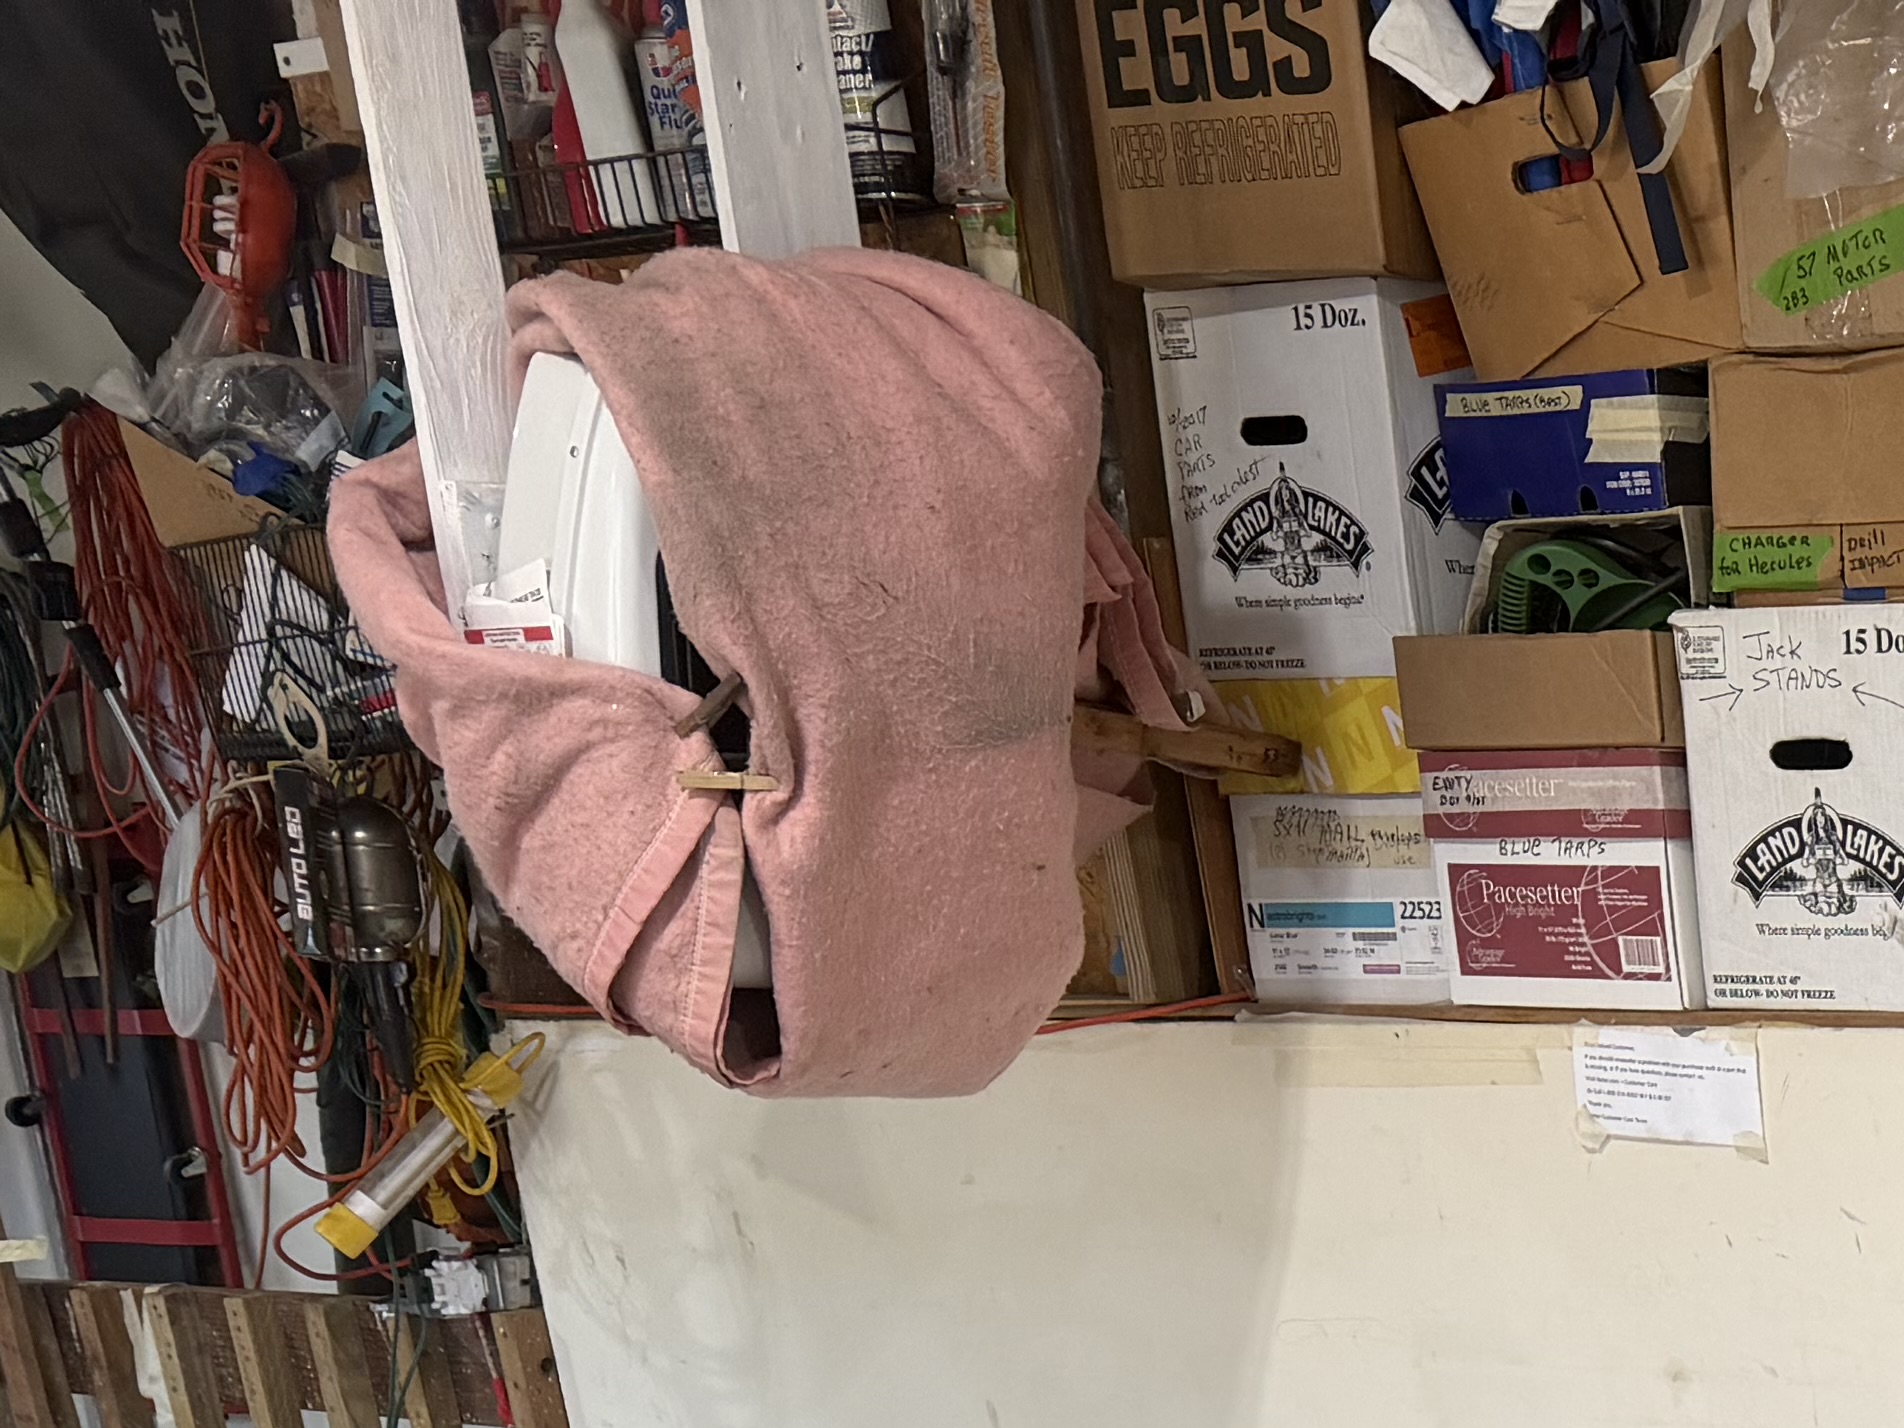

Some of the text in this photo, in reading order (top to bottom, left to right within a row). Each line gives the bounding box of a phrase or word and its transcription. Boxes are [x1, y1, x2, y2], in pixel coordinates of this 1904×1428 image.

[1094, 0, 1332, 109] EGGS
[1111, 111, 1342, 190] KEEP REFRIGERATED
[1291, 302, 1367, 331] 15 Doz.
[1222, 496, 1361, 555] LAND LAKES
[1842, 629, 1868, 655] 15
[1752, 665, 1842, 692] STANDS
[1551, 837, 1607, 858] TARPS
[1745, 826, 1800, 881] LAND
[1481, 879, 1582, 905] Pacesetter
[1400, 901, 1442, 919] 22523
[1756, 923, 1870, 940] Where simple goodness
[1780, 989, 1800, 999] NOT
[1801, 989, 1836, 1000] FREEZE
